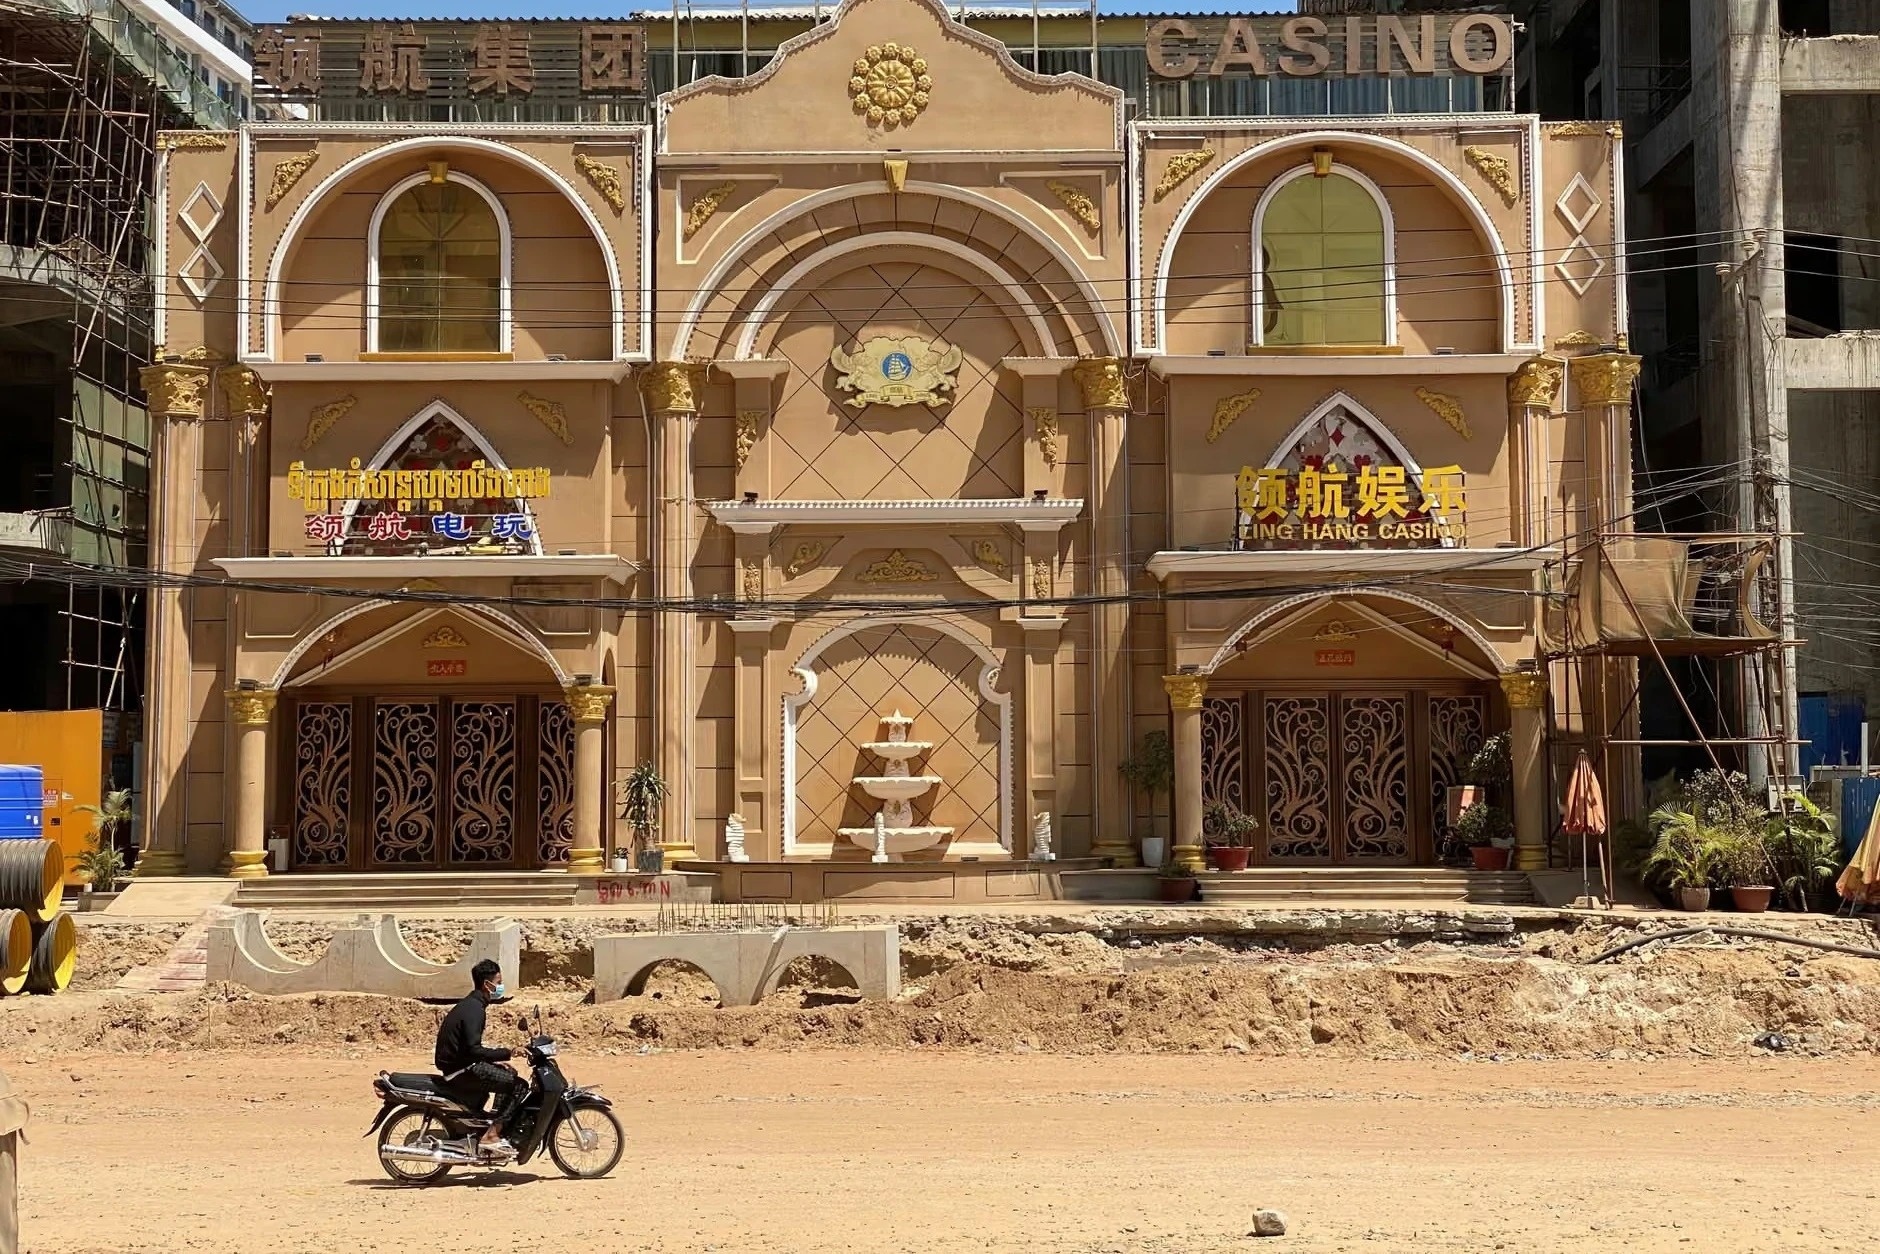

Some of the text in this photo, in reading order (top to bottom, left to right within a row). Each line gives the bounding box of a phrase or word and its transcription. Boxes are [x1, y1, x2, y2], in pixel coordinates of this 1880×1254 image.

[254, 23, 645, 94] 领航集团
[1146, 14, 1513, 77] CASINO
[1236, 463, 1469, 520] 领航娱乐
[304, 512, 534, 541] 领航电玩
[1239, 522, 1467, 541] LING HANG CASINO
